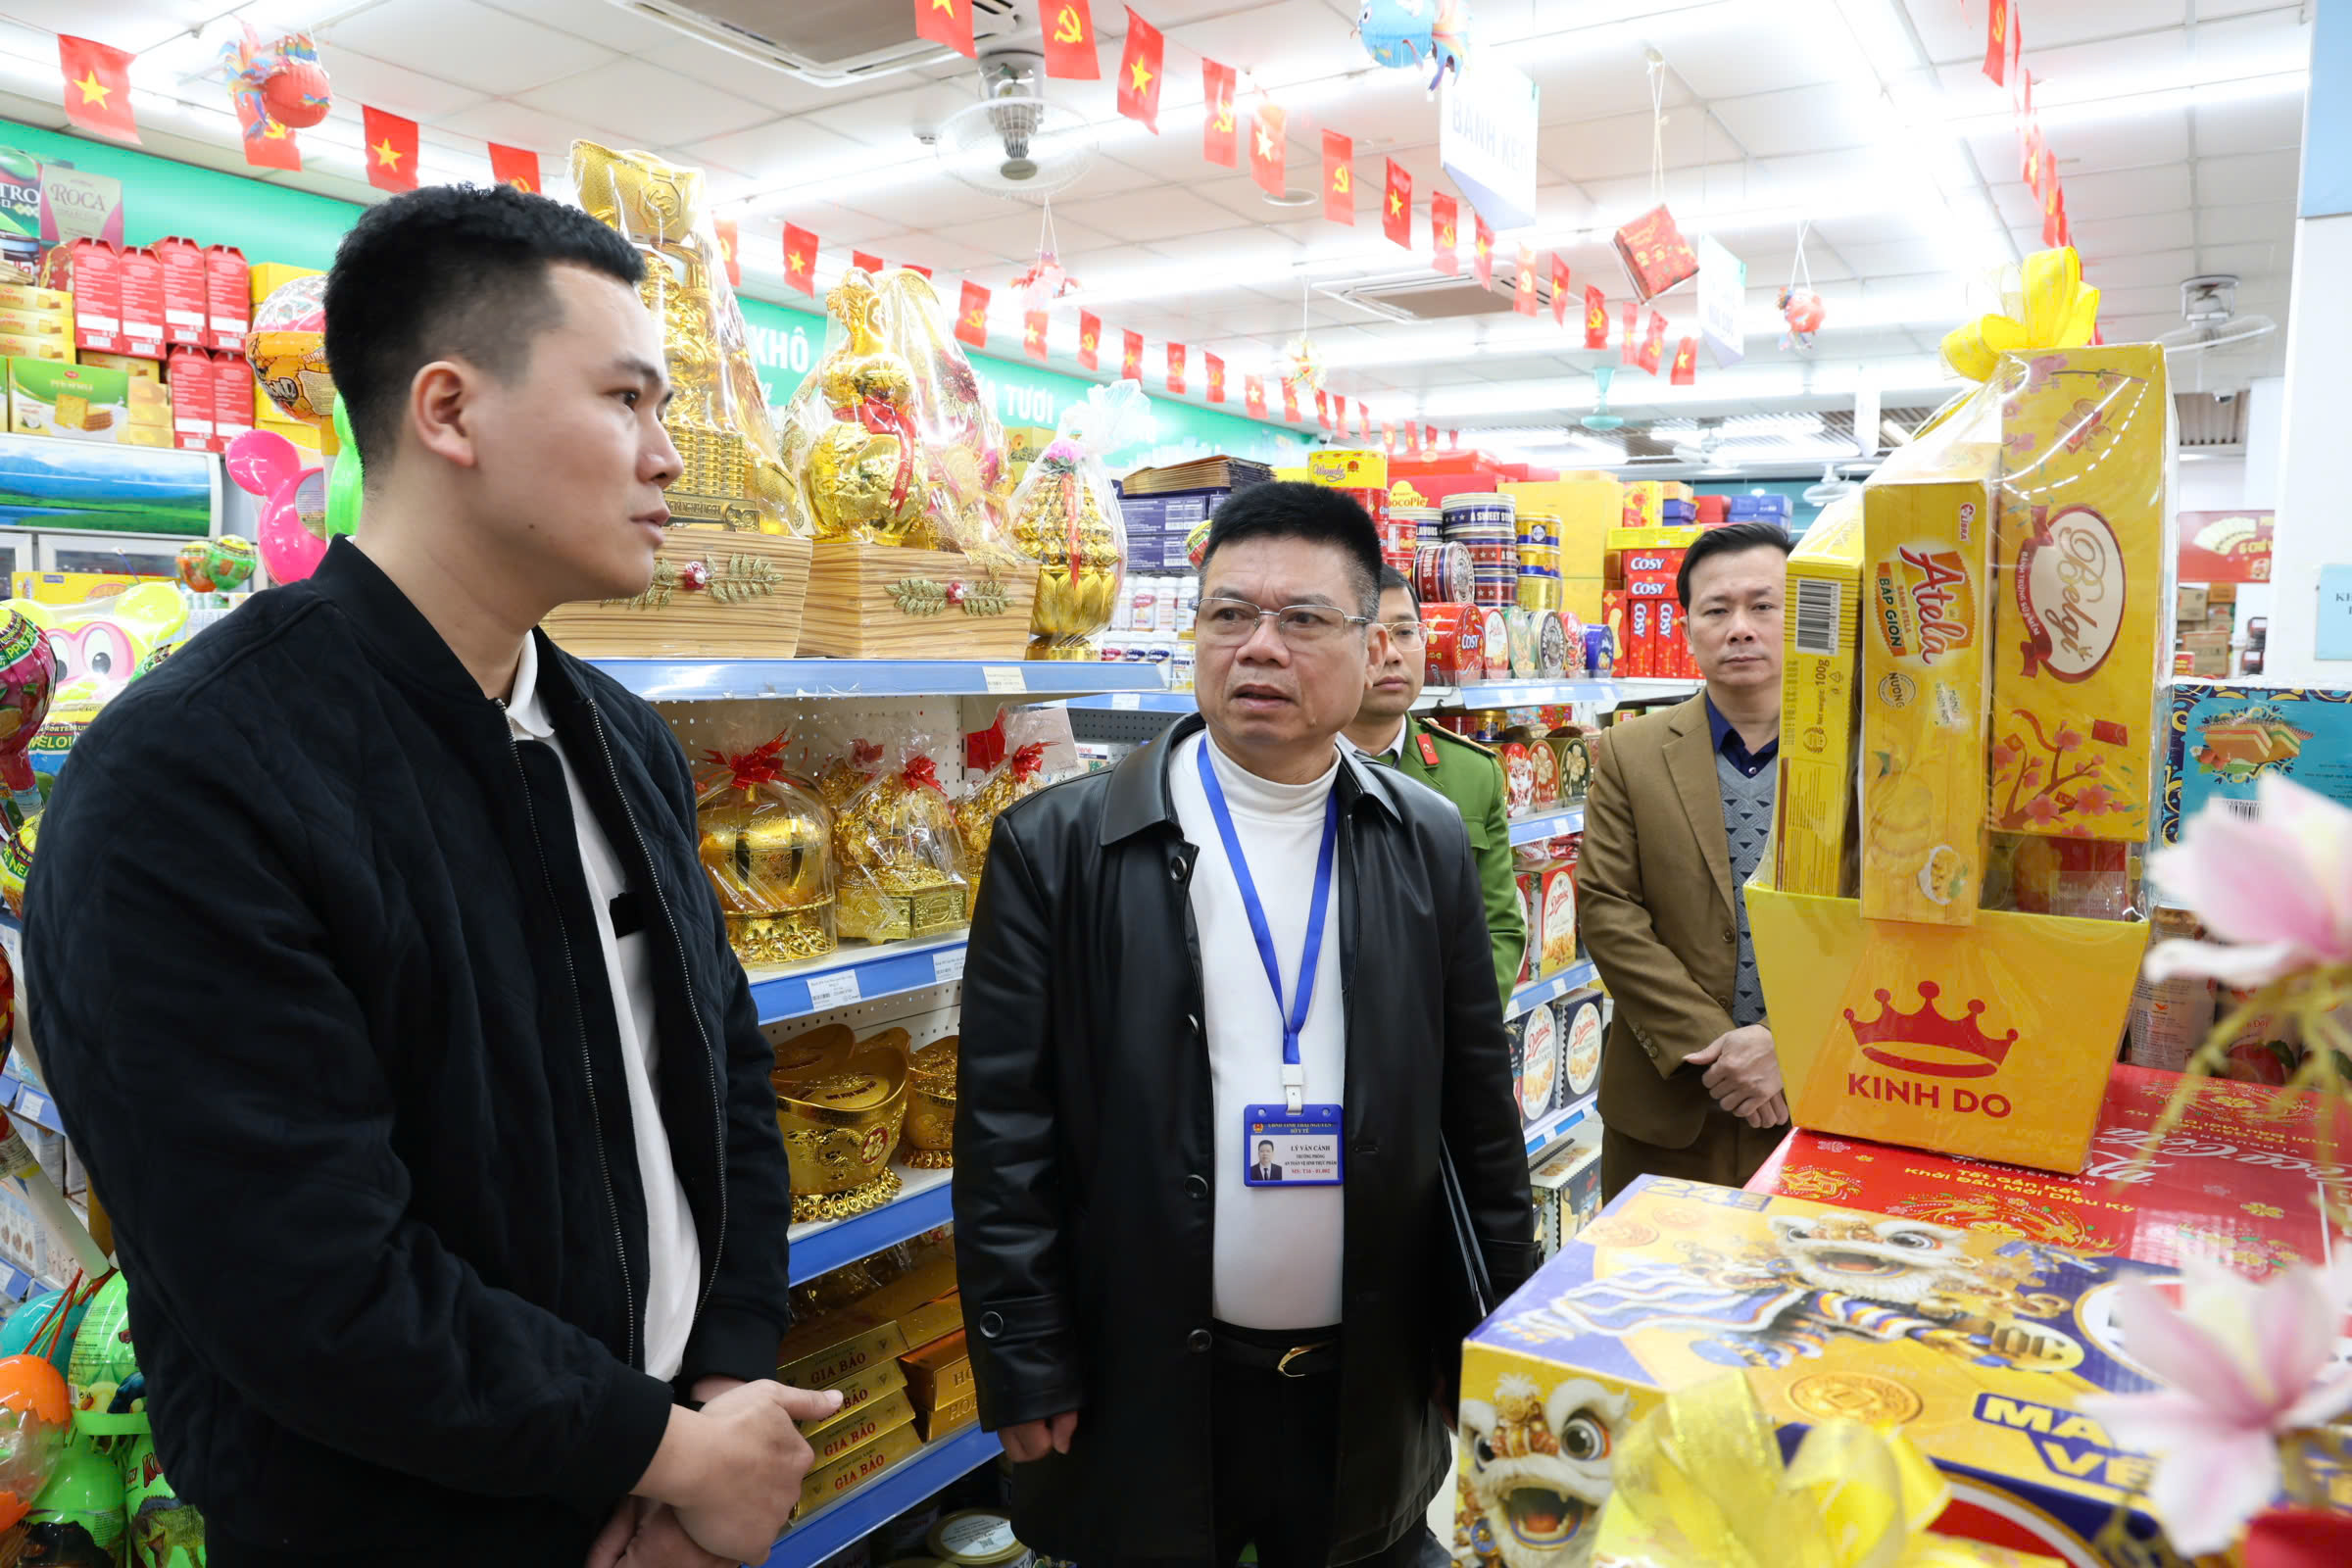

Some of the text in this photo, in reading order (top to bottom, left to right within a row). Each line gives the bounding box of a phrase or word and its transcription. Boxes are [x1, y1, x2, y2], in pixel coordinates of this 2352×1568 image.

[50, 183, 107, 213] ROCA
[1004, 383, 1054, 424] TƯƠI
[1477, 512, 1499, 521] SWEET
[1631, 557, 1666, 570] COSY
[1632, 581, 1667, 596] COSY
[1899, 546, 1967, 664] Atela
[1634, 603, 1647, 638] COSY
[1659, 603, 1674, 639] COSY
[1461, 635, 1480, 650] COSY
[1815, 659, 1831, 686] 100g
[1848, 1073, 2012, 1118] KINH DO
[1959, 1169, 1991, 1181] Tết
[843, 1389, 869, 1409] BẢO
[824, 1442, 849, 1457] GIA
[851, 1421, 877, 1444] BẢO
[834, 1473, 858, 1491] GIA
[859, 1453, 885, 1476] BẢO
